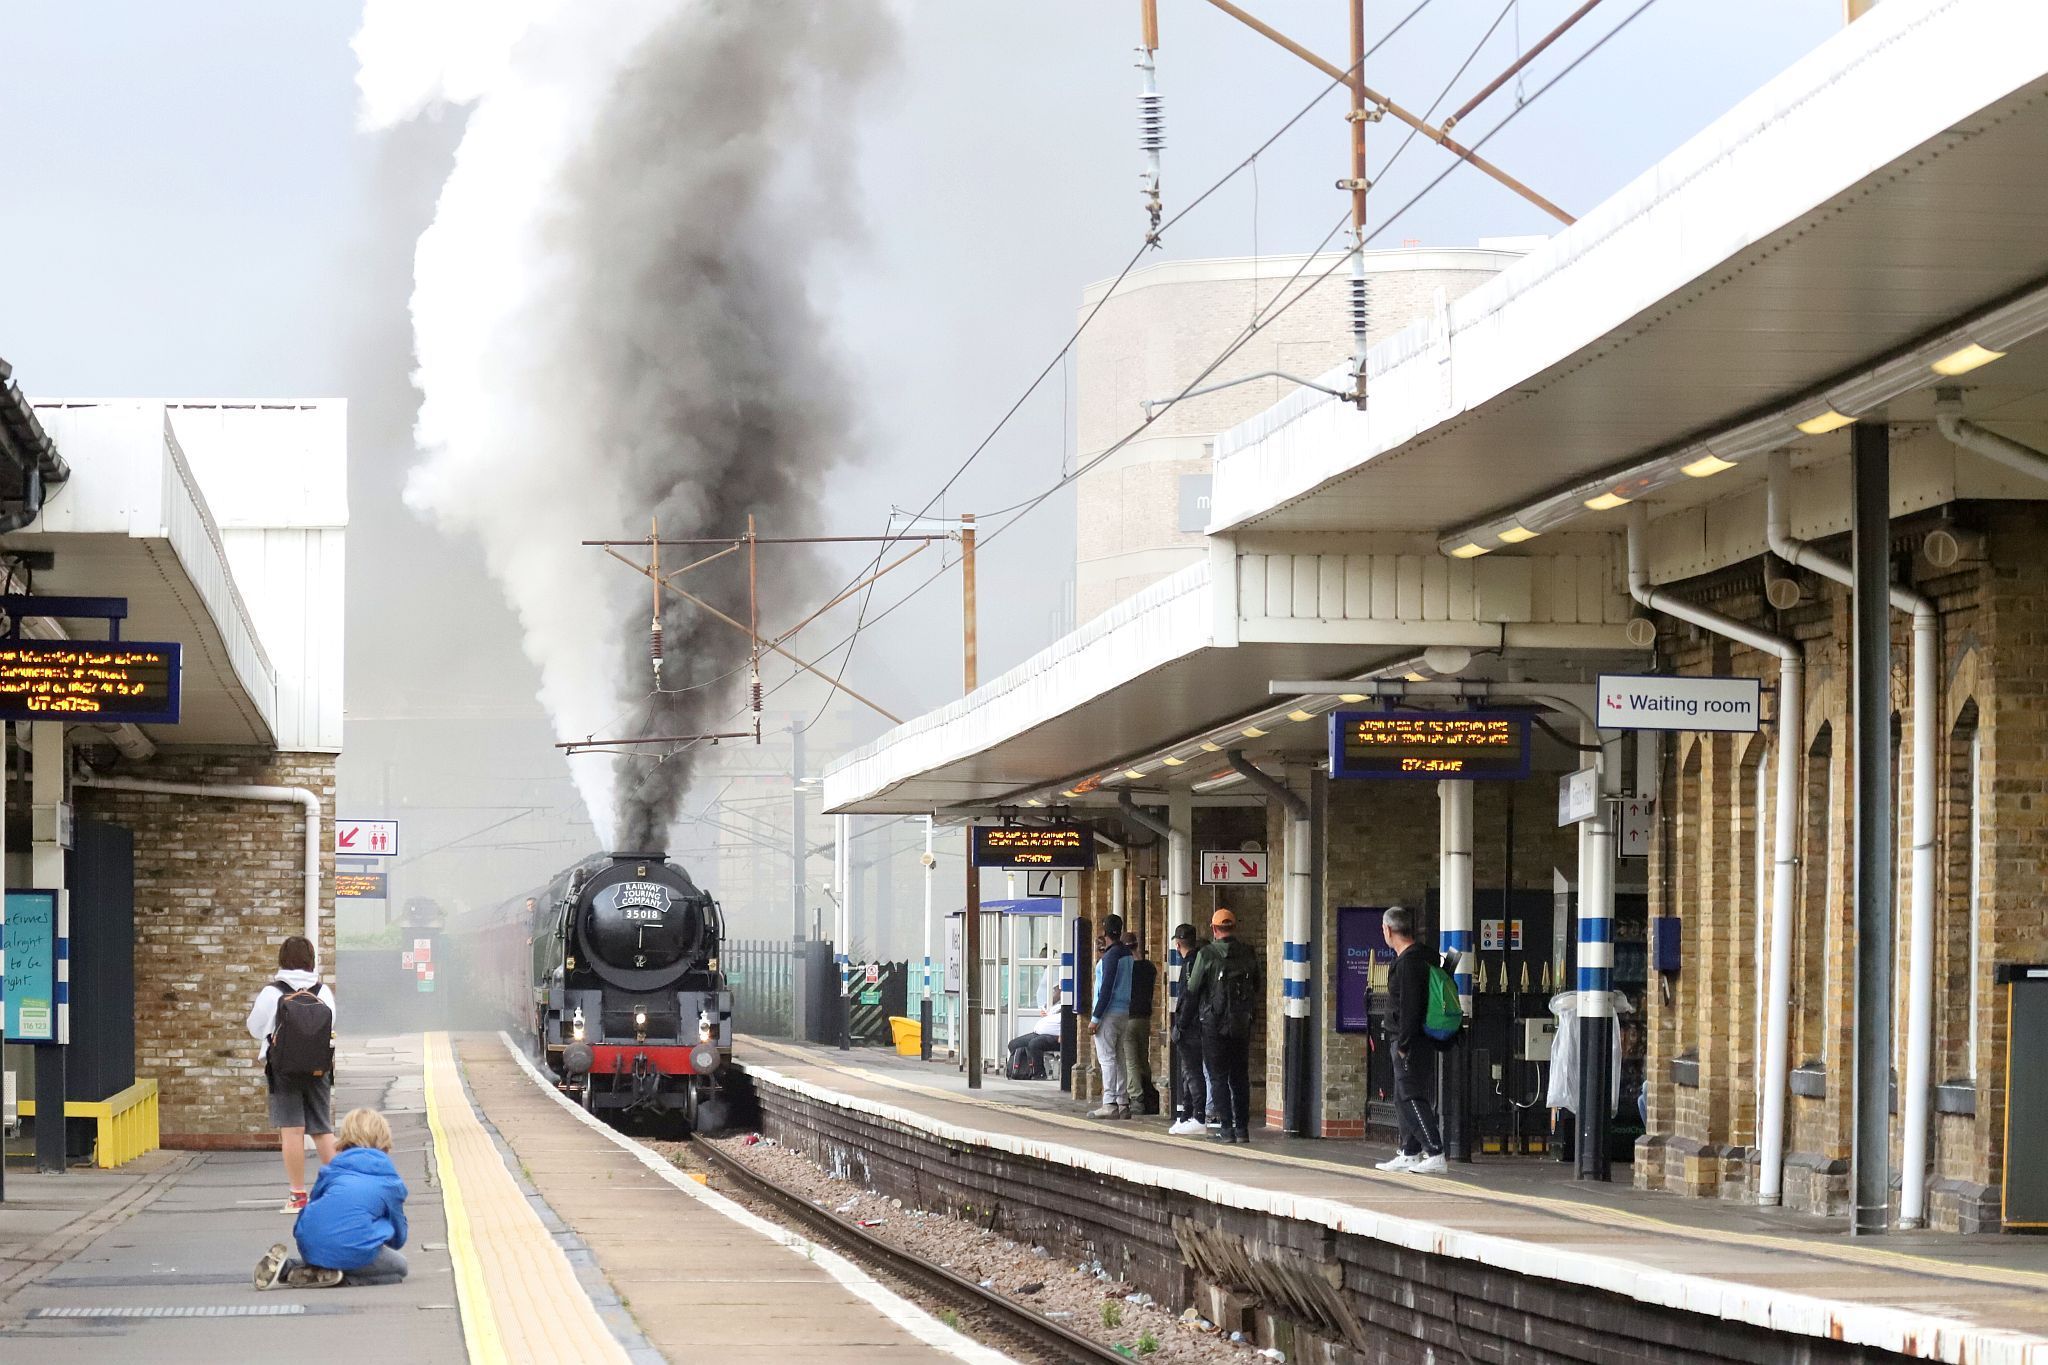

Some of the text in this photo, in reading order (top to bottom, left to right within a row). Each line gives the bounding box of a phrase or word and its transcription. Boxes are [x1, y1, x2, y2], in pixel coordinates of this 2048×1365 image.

[1629, 694, 1751, 716] Waiting room
[625, 883, 662, 893] RAILWAY
[623, 890, 662, 900] TOURING
[622, 897, 663, 908] COMPANY
[626, 910, 658, 919] 35018
[1347, 947, 1395, 957] Don' risk
[11, 956, 41, 969] to be
[35, 1022, 47, 1030] 123
